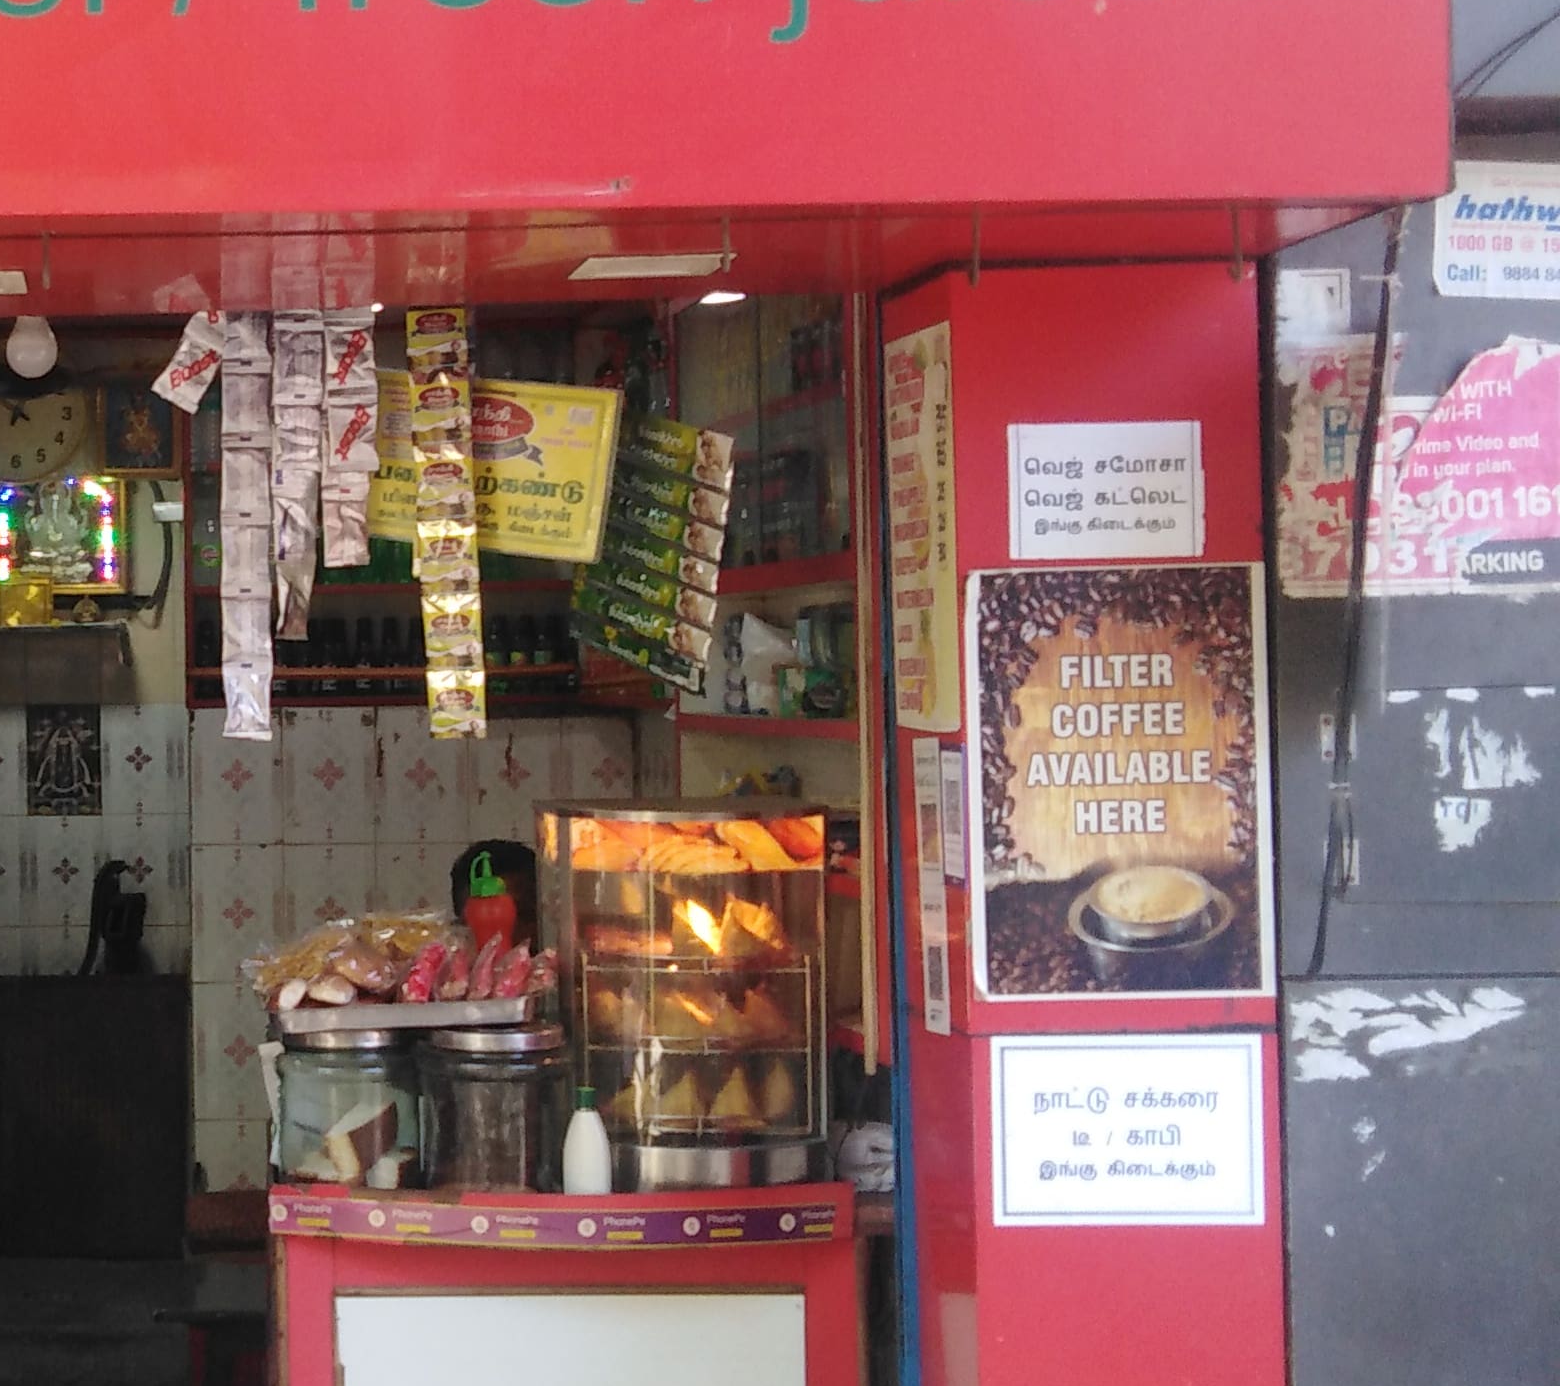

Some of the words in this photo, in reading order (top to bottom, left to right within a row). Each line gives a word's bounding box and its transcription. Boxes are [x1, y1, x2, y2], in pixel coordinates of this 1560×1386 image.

[1447, 264, 1487, 282] Call:
[1460, 379, 1513, 400] WITH
[61, 406, 72, 420] 3
[53, 431, 64, 445] 4
[1414, 438, 1452, 455] rime
[1456, 435, 1504, 453] Video
[1508, 431, 1539, 449] and
[10, 455, 22, 468] 6
[36, 449, 46, 463] 5
[1024, 457, 1083, 479] வெஜ்
[1094, 455, 1187, 474] சமோசா
[1434, 462, 1471, 480] your
[1024, 489, 1083, 511] வெஜ்
[1034, 517, 1082, 535] இங்கு
[1087, 516, 1176, 534] கிடைக்கும்
[1460, 549, 1545, 574] ARKING
[1059, 653, 1174, 690] FILTER
[1050, 701, 1186, 739] COFFEE
[1026, 749, 1213, 788] AVAILABLE
[1075, 798, 1167, 835] HERE
[1033, 1086, 1110, 1115] நாட்டு
[1123, 1086, 1219, 1113] சக்கரை
[1126, 1123, 1182, 1147] காபி
[1039, 1160, 1098, 1181] இங்கு
[1106, 1159, 1217, 1181] கிடைக்கும்
